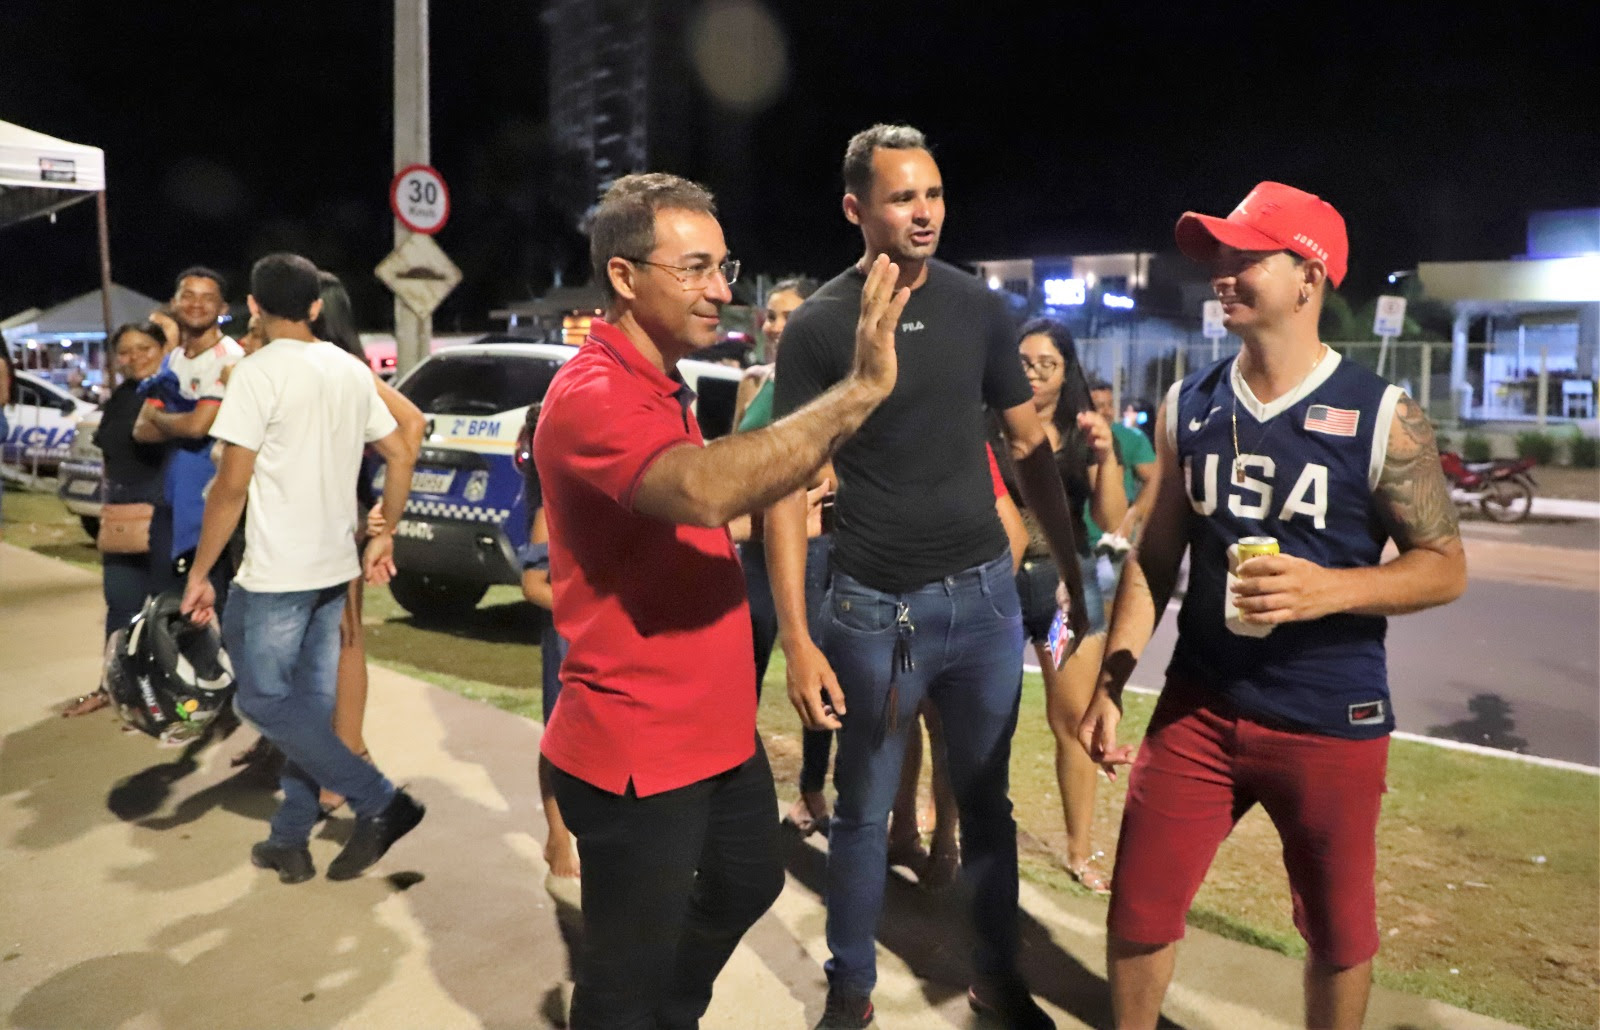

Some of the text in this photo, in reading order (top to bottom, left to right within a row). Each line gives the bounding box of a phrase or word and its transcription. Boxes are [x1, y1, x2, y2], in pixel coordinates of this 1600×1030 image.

[408, 179, 437, 205] 30
[1293, 233, 1329, 261] JORDAN
[902, 320, 925, 332] FILA
[467, 420, 500, 437] BPM
[1184, 453, 1328, 530] USA
